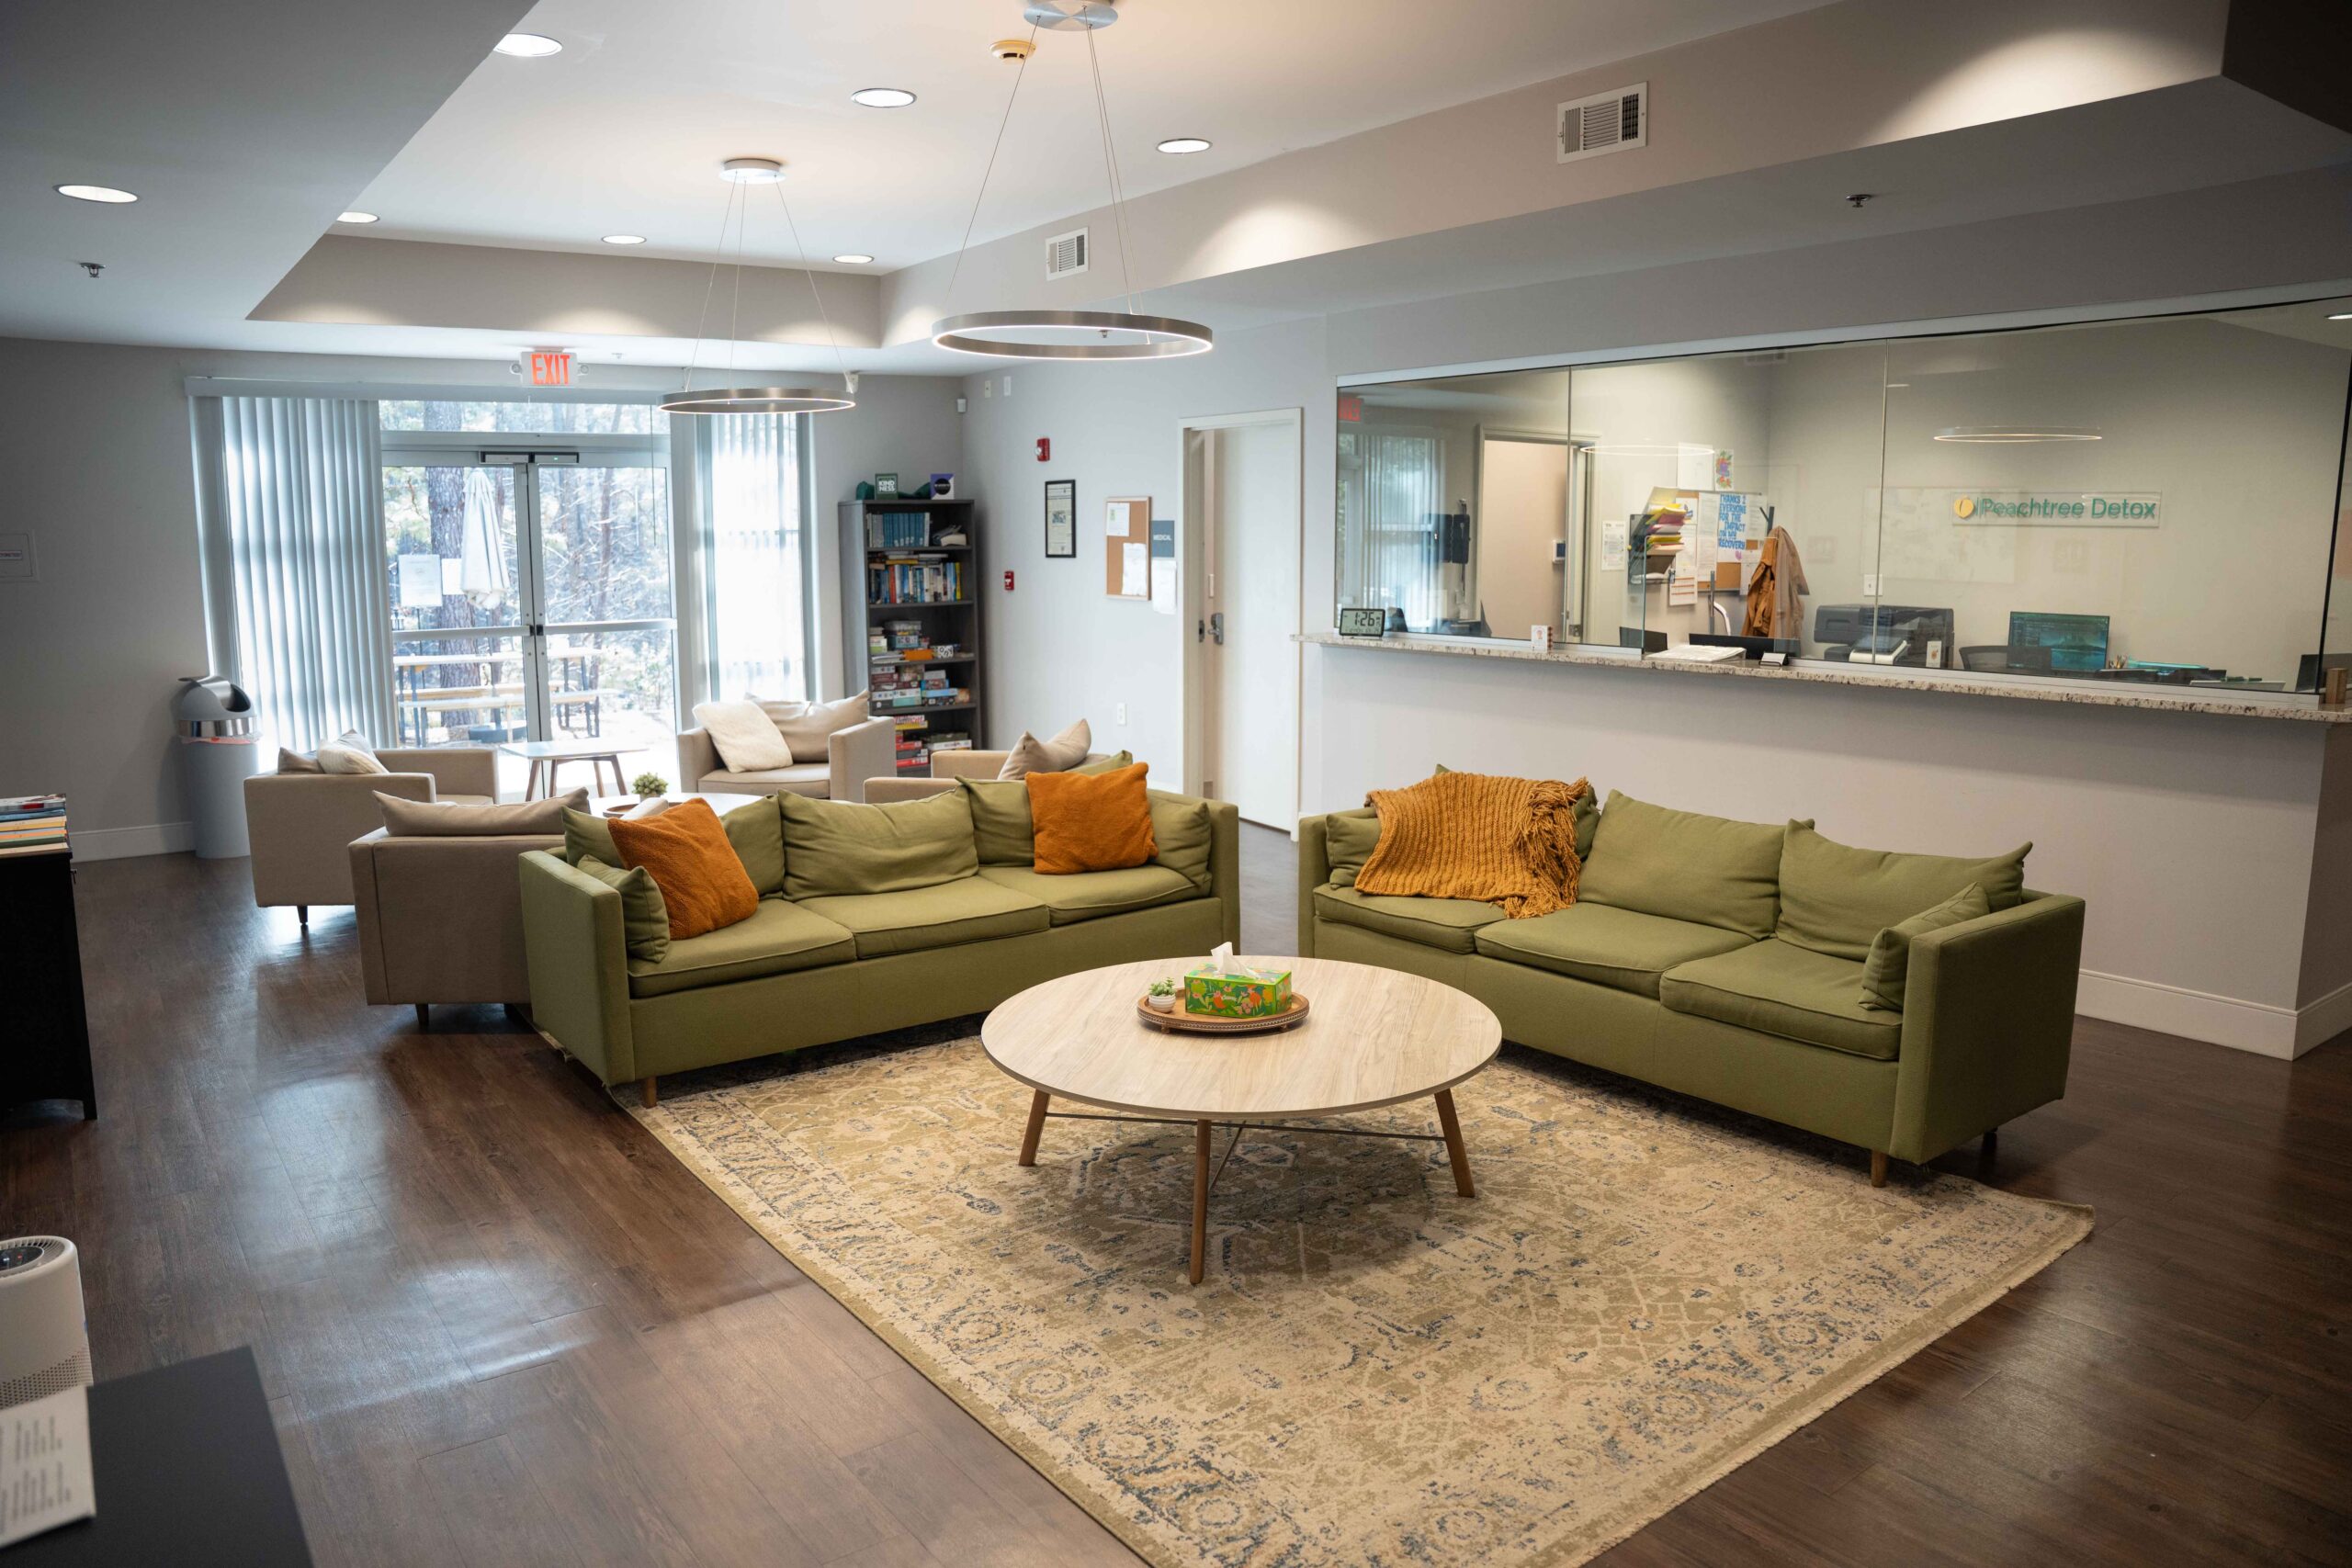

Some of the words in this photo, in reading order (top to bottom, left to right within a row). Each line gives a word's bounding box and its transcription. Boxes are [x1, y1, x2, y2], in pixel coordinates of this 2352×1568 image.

[531, 354, 571, 385] EXIT
[1981, 497, 2085, 518] Peachtree
[2091, 497, 2157, 519] Detox
[1731, 513, 1741, 522] THE
[1354, 611, 1375, 626] 1:26
